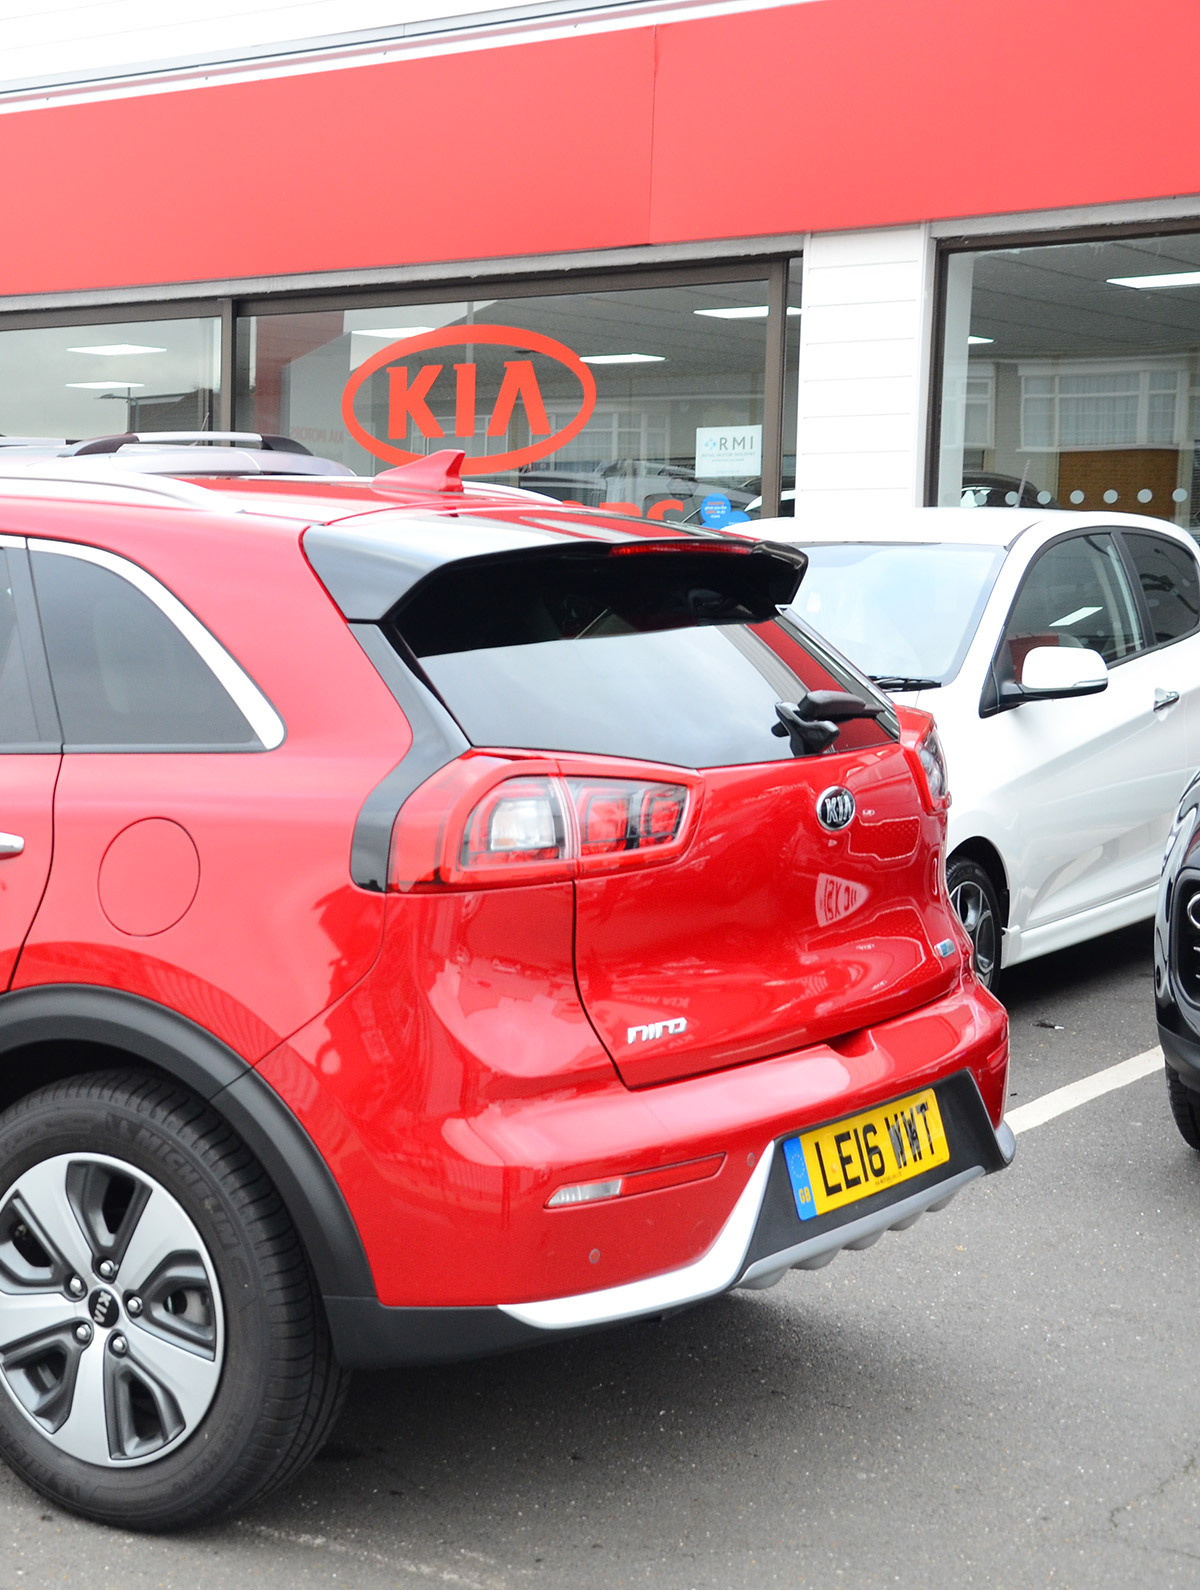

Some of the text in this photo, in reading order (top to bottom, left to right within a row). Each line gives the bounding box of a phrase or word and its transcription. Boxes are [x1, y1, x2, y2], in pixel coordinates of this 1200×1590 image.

[386, 360, 551, 440] KIA
[719, 436, 754, 450] RMI
[825, 795, 852, 823] KIA
[814, 1122, 885, 1197] LE16
[798, 1186, 812, 1204] GB
[93, 1291, 112, 1323] KIA
